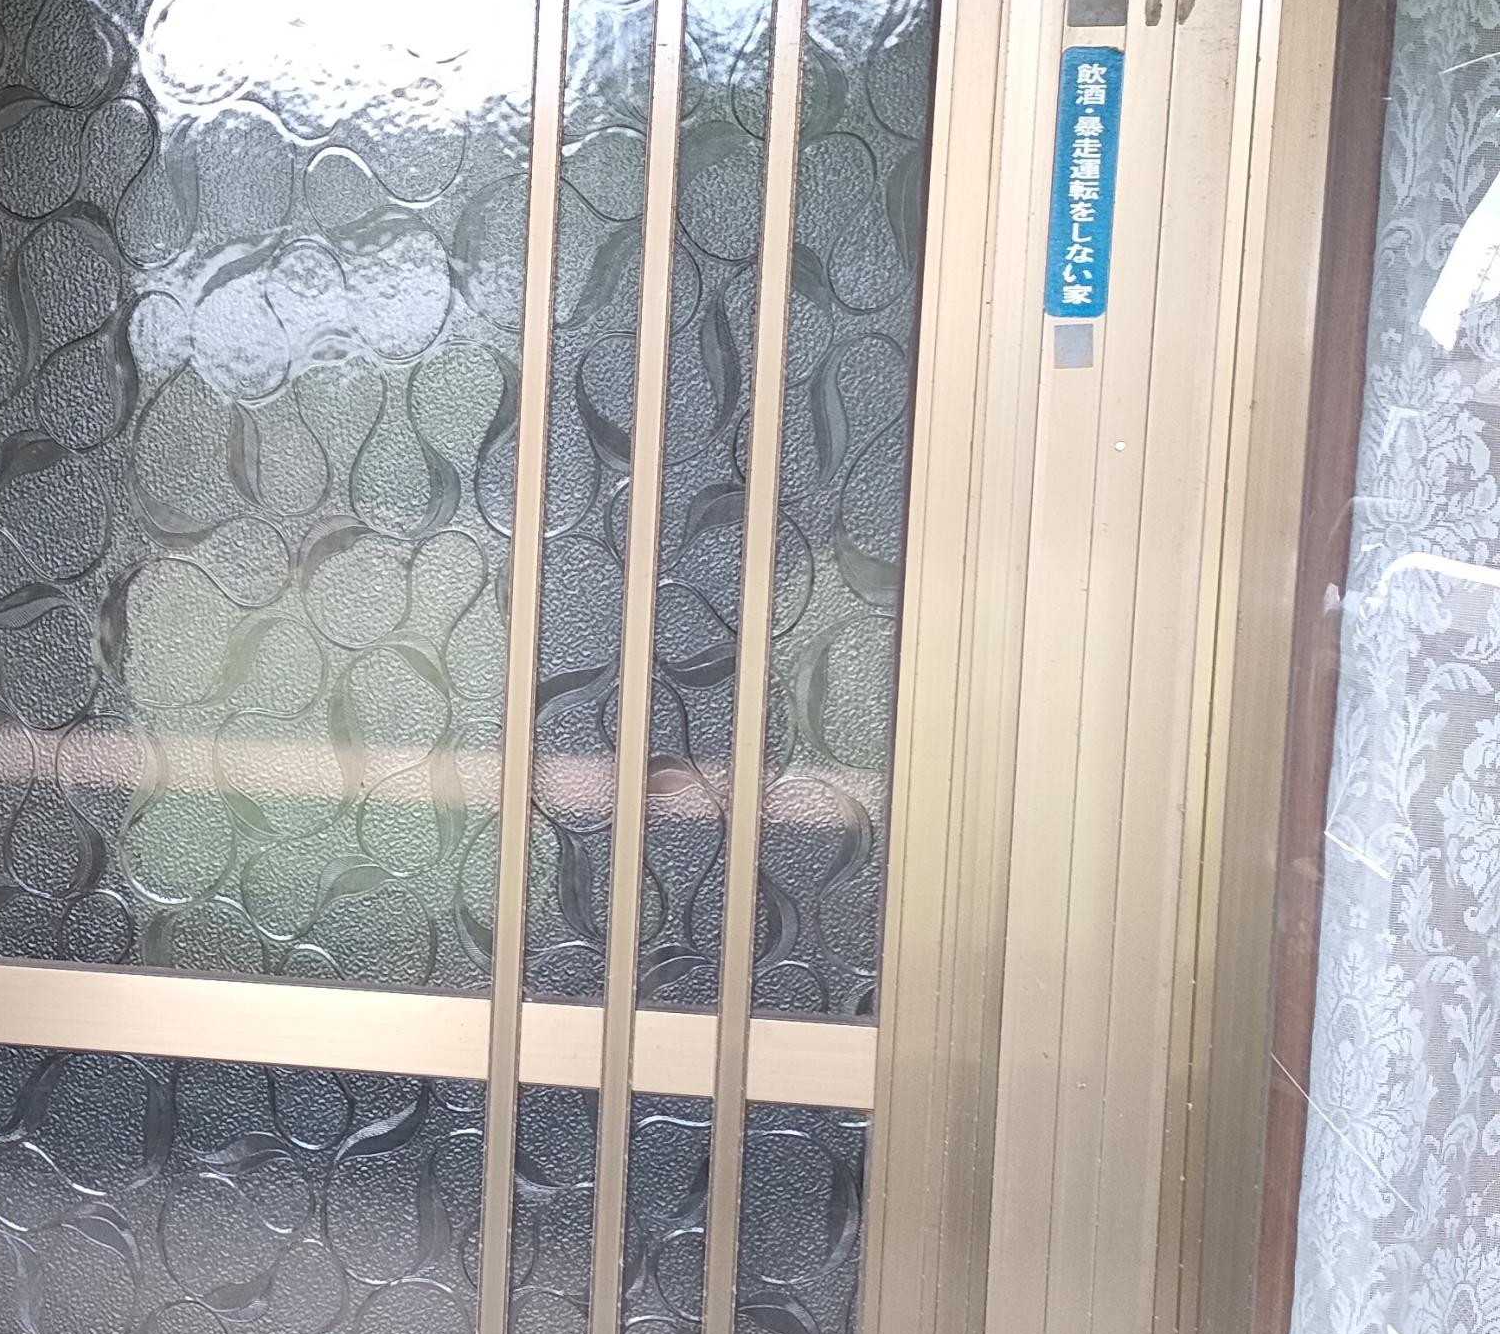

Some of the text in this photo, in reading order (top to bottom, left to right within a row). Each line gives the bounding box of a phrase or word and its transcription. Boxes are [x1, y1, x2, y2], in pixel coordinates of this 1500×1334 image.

[1061, 63, 1108, 305] 飲酒・暴走運転をしない家
